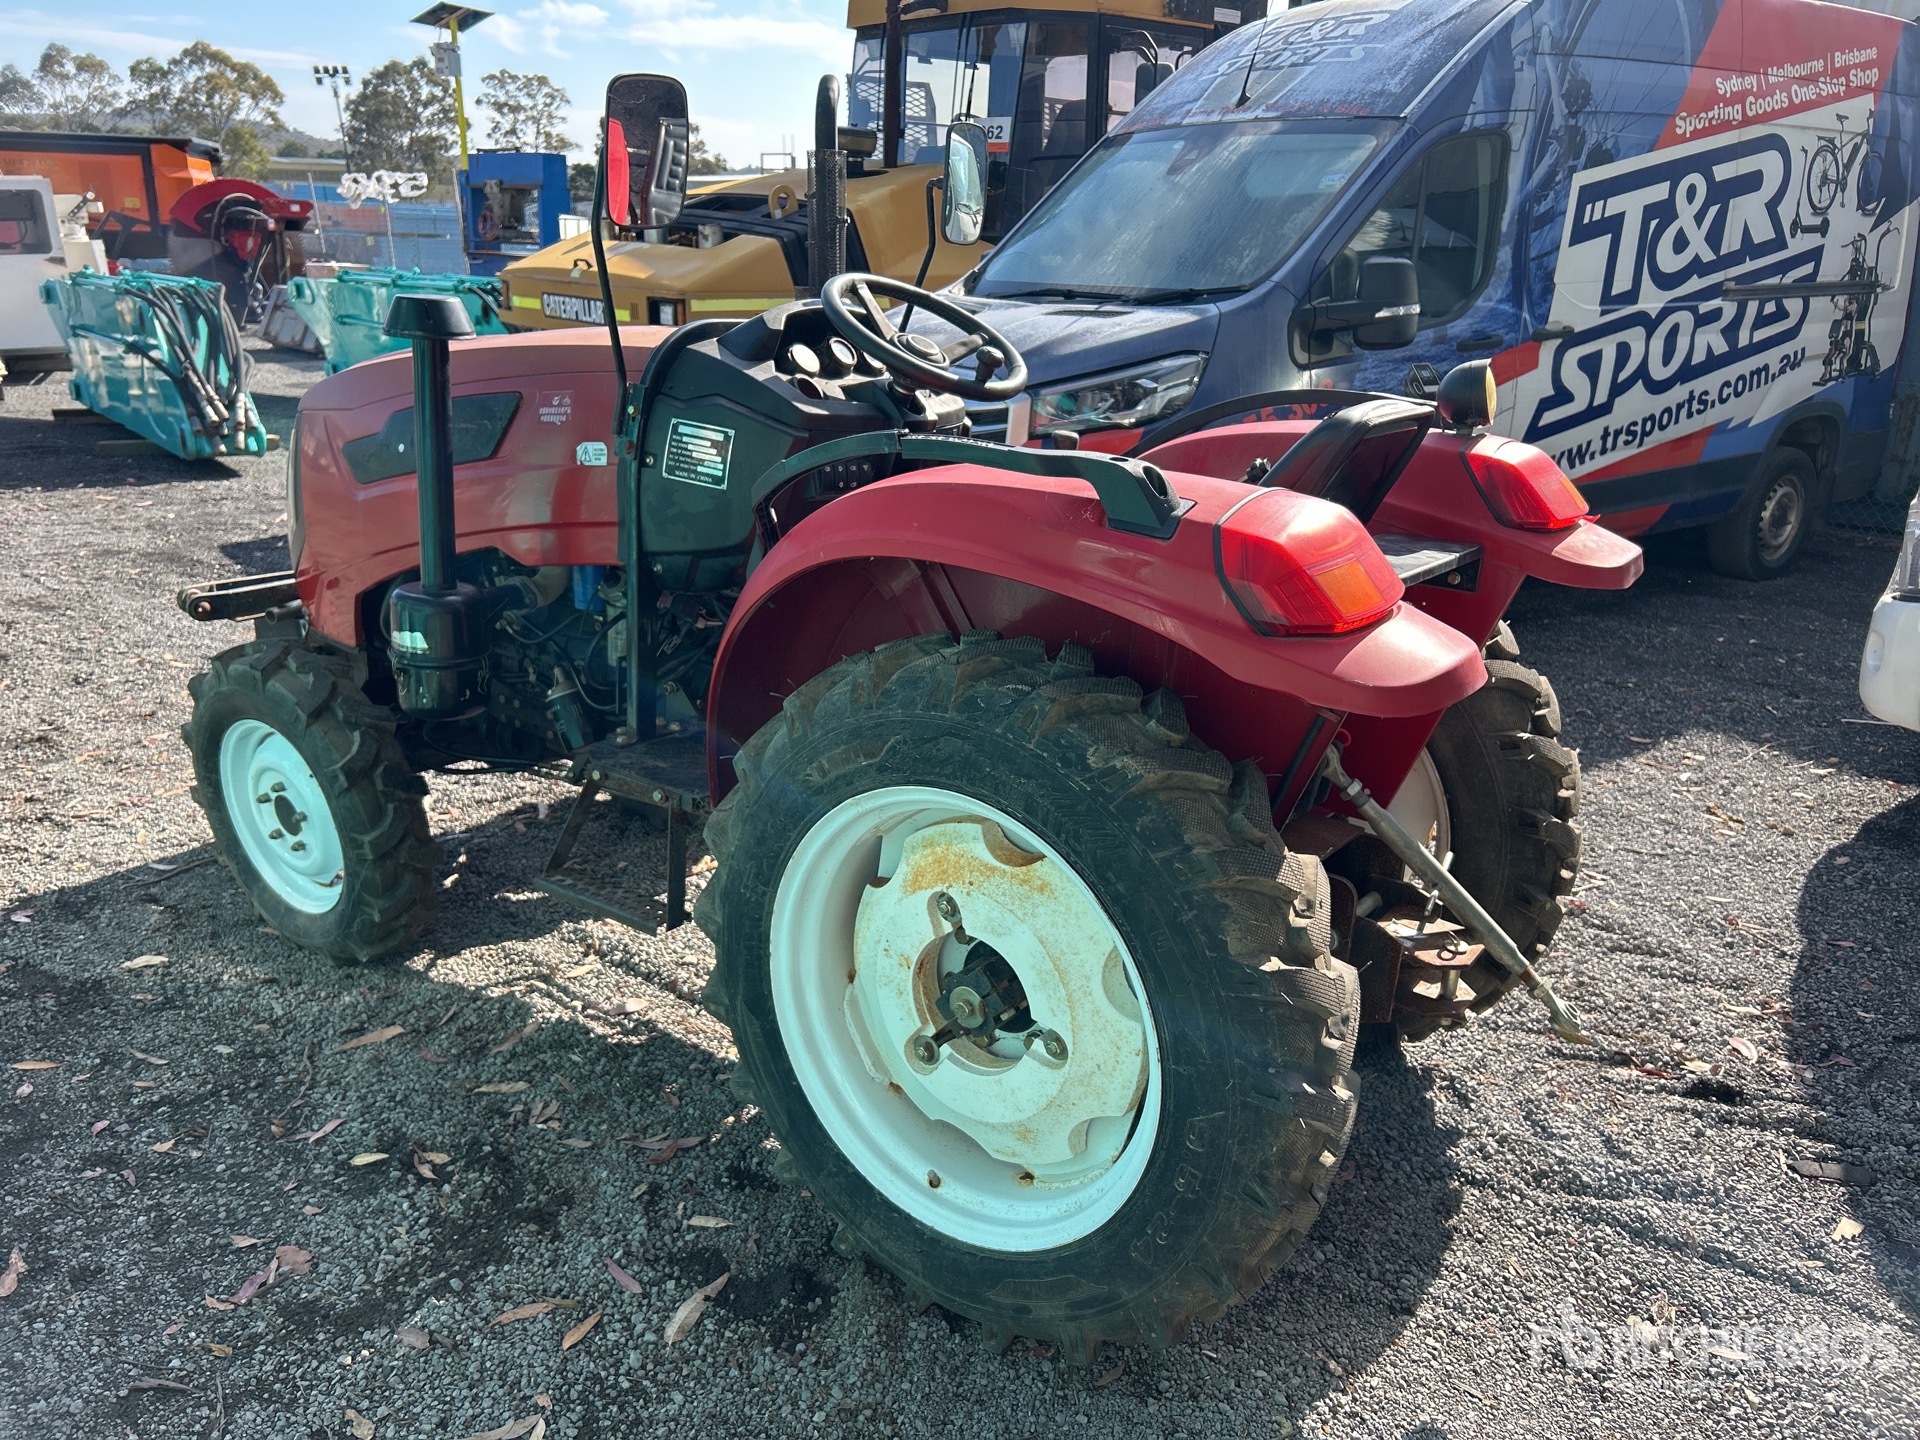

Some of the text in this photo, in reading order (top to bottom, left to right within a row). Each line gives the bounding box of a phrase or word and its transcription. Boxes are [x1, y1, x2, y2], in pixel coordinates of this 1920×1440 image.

[1675, 67, 1879, 137] Sporting Goods One-Stop Shop
[1715, 73, 1758, 98] Sydney
[1767, 58, 1825, 84] Melbourne
[1834, 46, 1878, 68] Brisbane
[983, 125, 1004, 140] 62
[1583, 149, 1786, 298] T&R
[543, 294, 605, 325] CATERPILLAR
[1538, 261, 1816, 428] SPORTS
[1551, 346, 1807, 470] w.trsports.com.au
